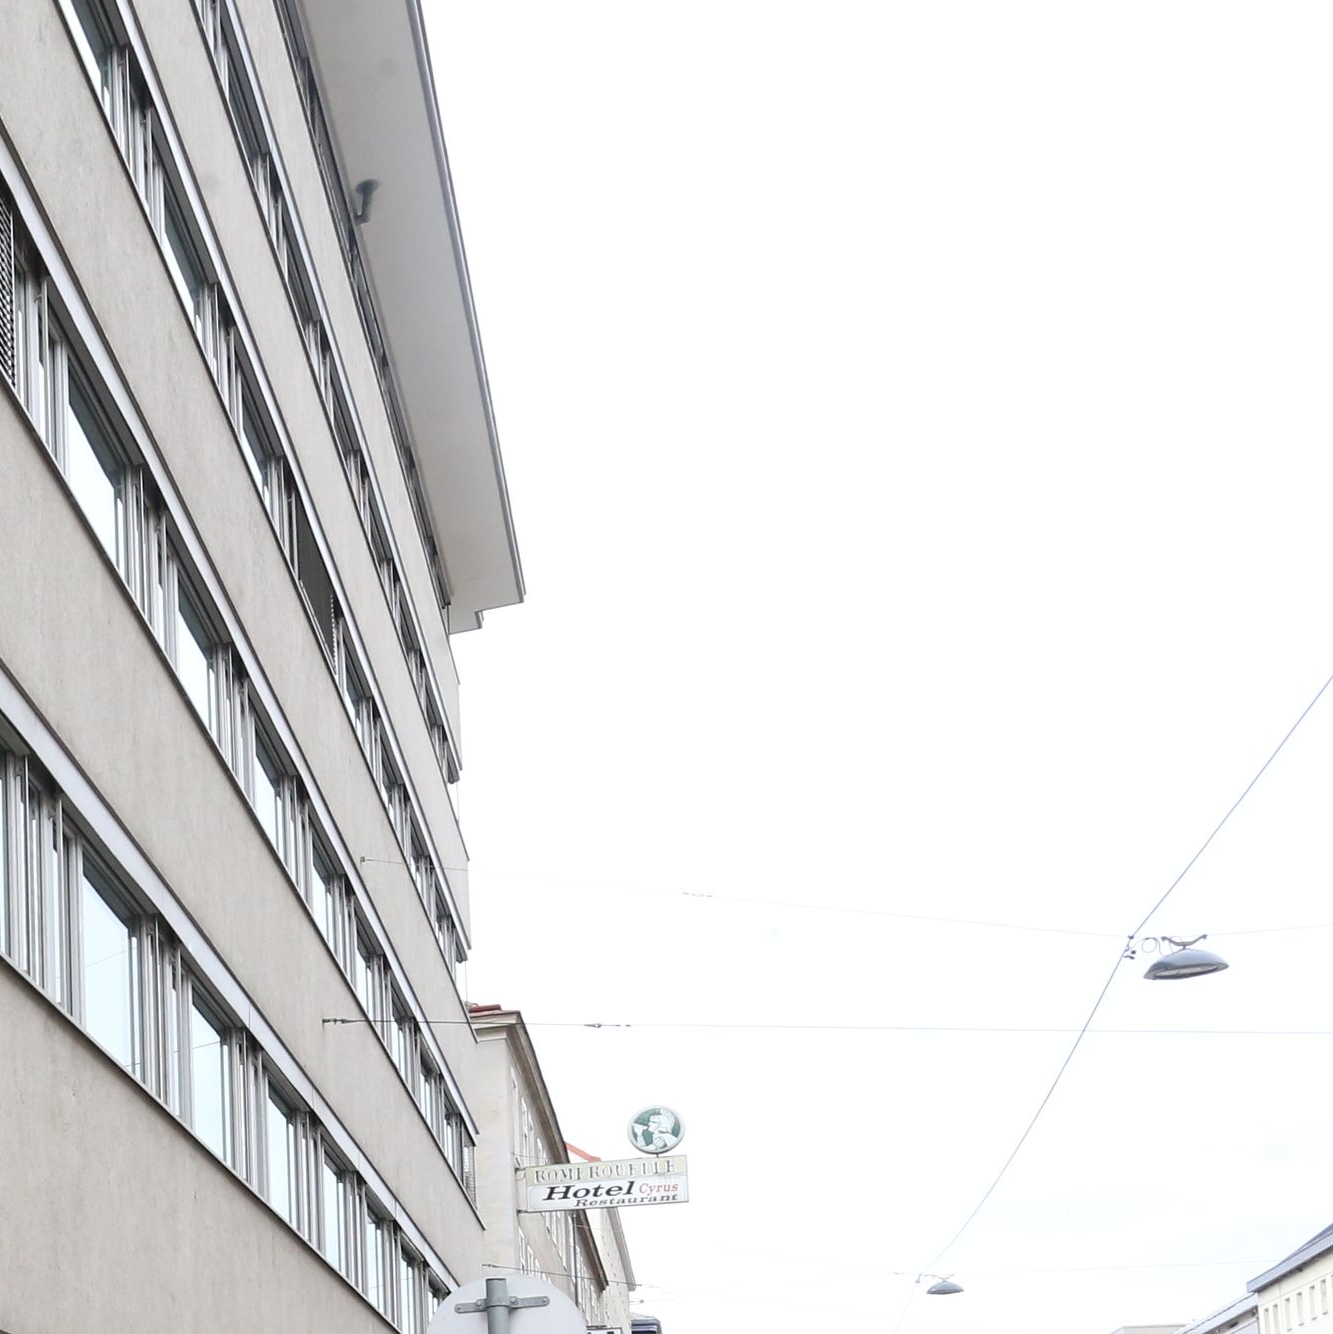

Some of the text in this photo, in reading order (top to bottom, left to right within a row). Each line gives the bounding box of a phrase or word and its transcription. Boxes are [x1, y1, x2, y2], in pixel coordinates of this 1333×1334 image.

[542, 1181, 679, 1201] Hotel Cyrus
[574, 1193, 678, 1208] Restaurant
